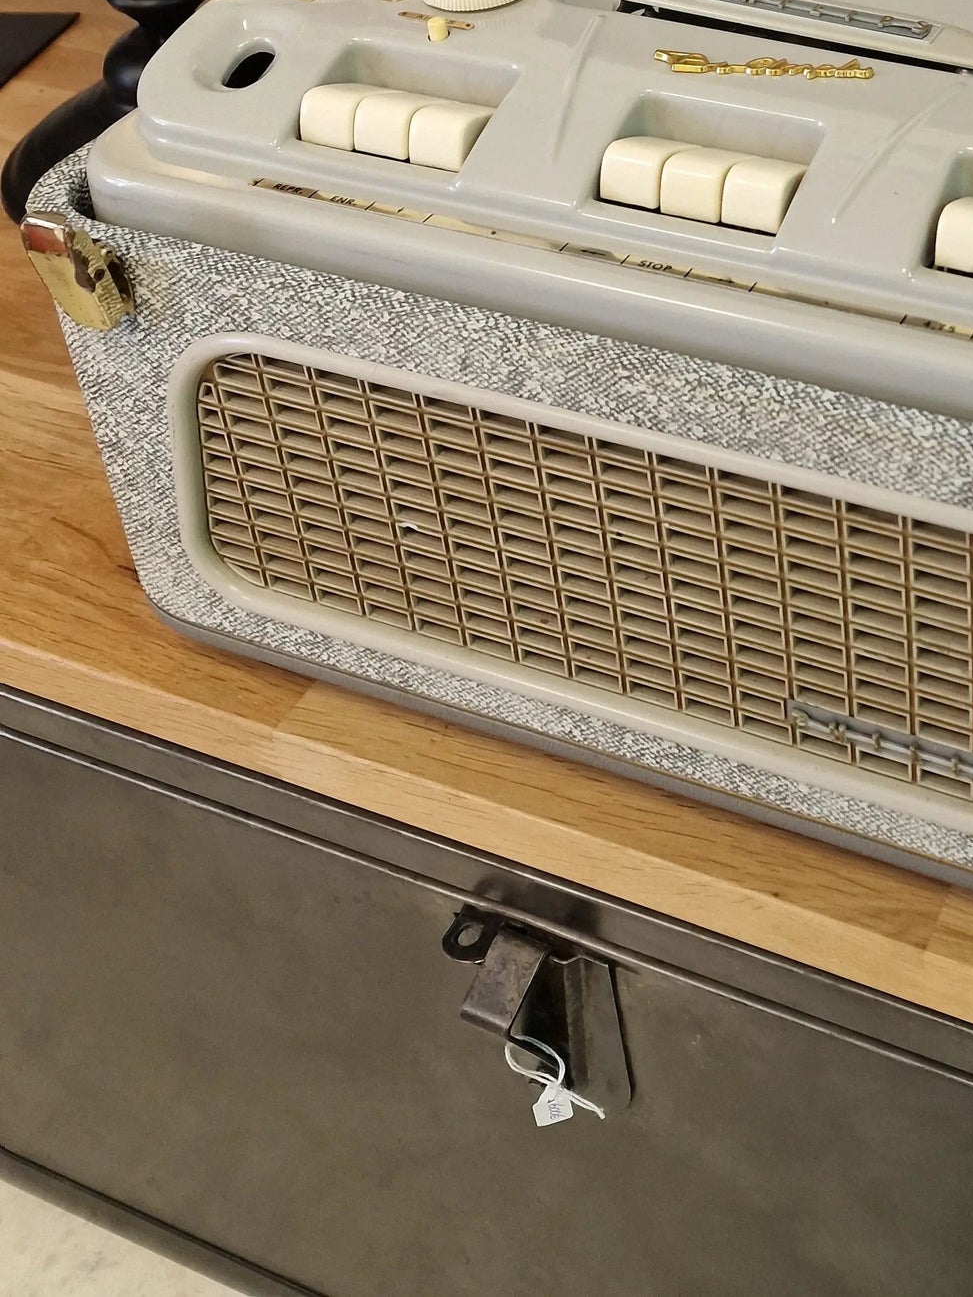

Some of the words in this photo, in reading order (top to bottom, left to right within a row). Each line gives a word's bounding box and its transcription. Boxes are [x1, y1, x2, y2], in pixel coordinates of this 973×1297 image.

[273, 182, 304, 195] REPR.
[330, 194, 357, 207] ENR.
[638, 259, 673, 272] STOP
